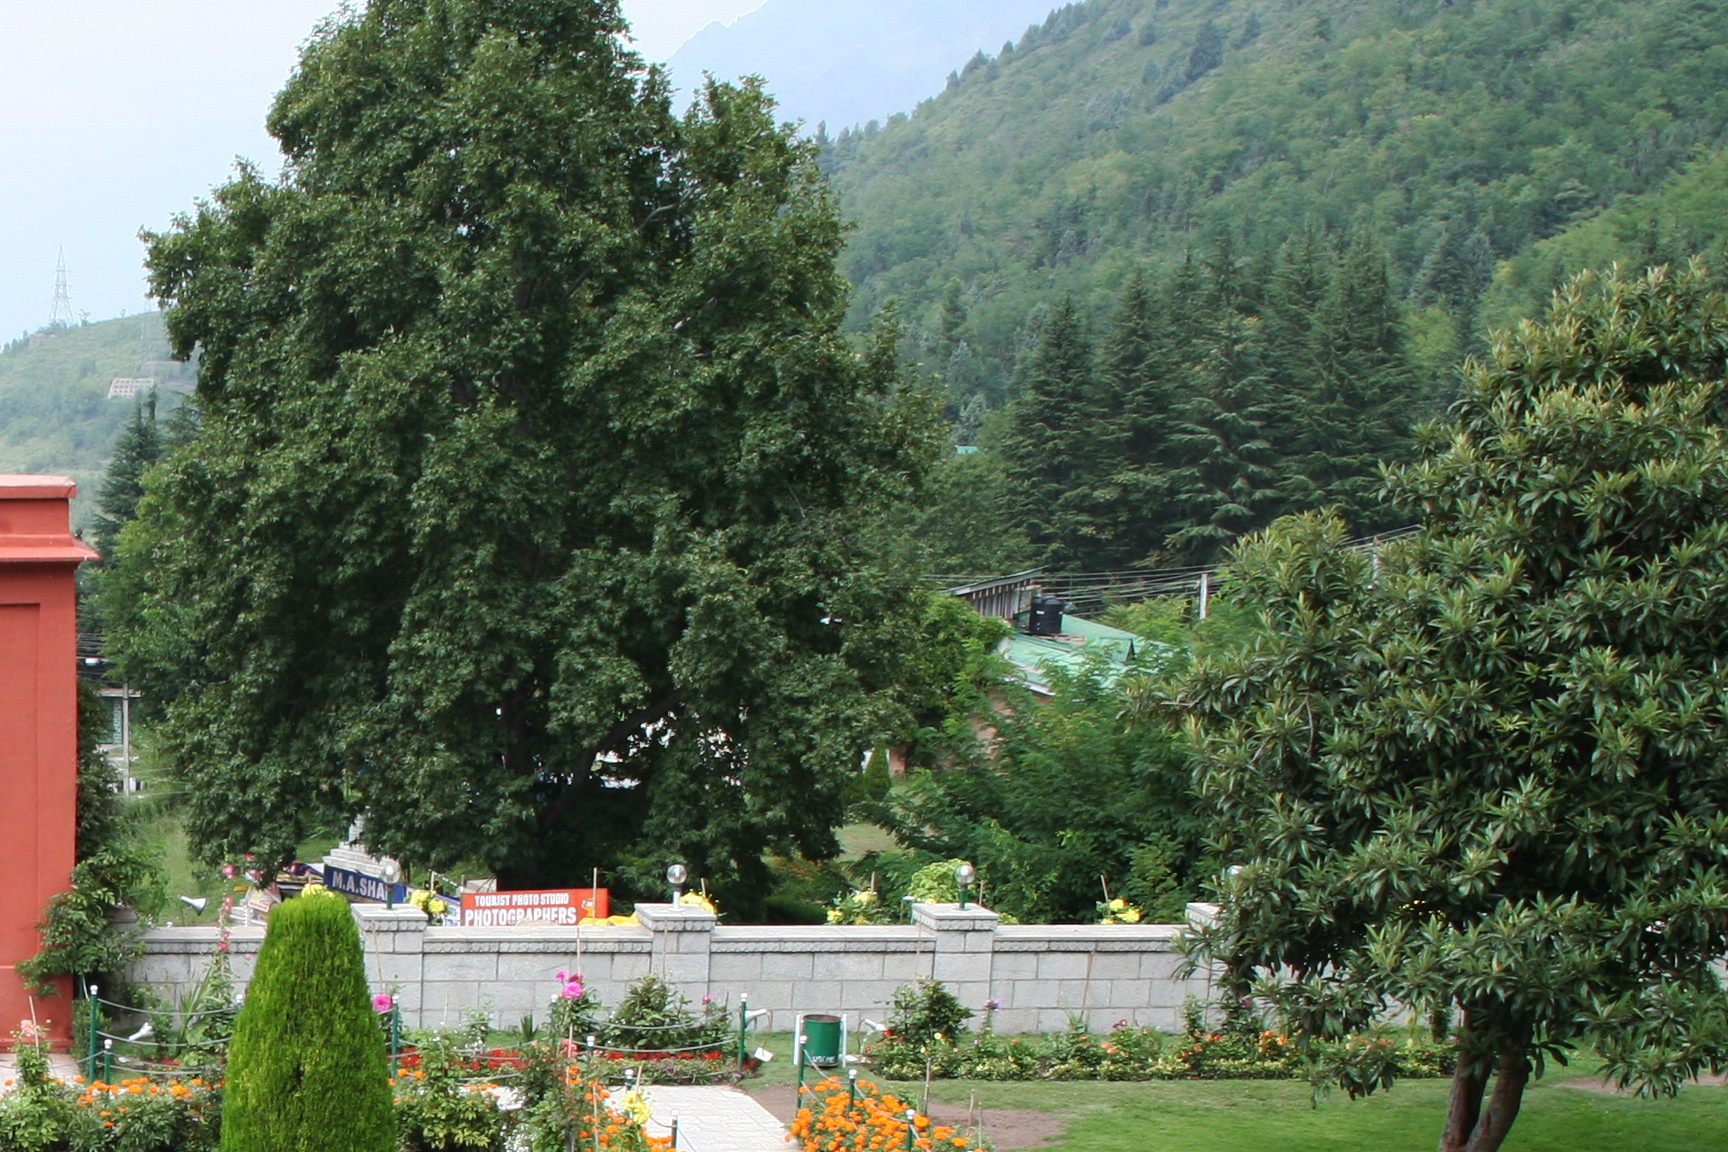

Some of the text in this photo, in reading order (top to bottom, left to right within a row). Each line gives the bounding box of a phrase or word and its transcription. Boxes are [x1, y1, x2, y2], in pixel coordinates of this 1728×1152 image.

[474, 892, 570, 907] TOURIST PHOTO STUDIO
[464, 906, 577, 926] PHOTOGRAPHERS
